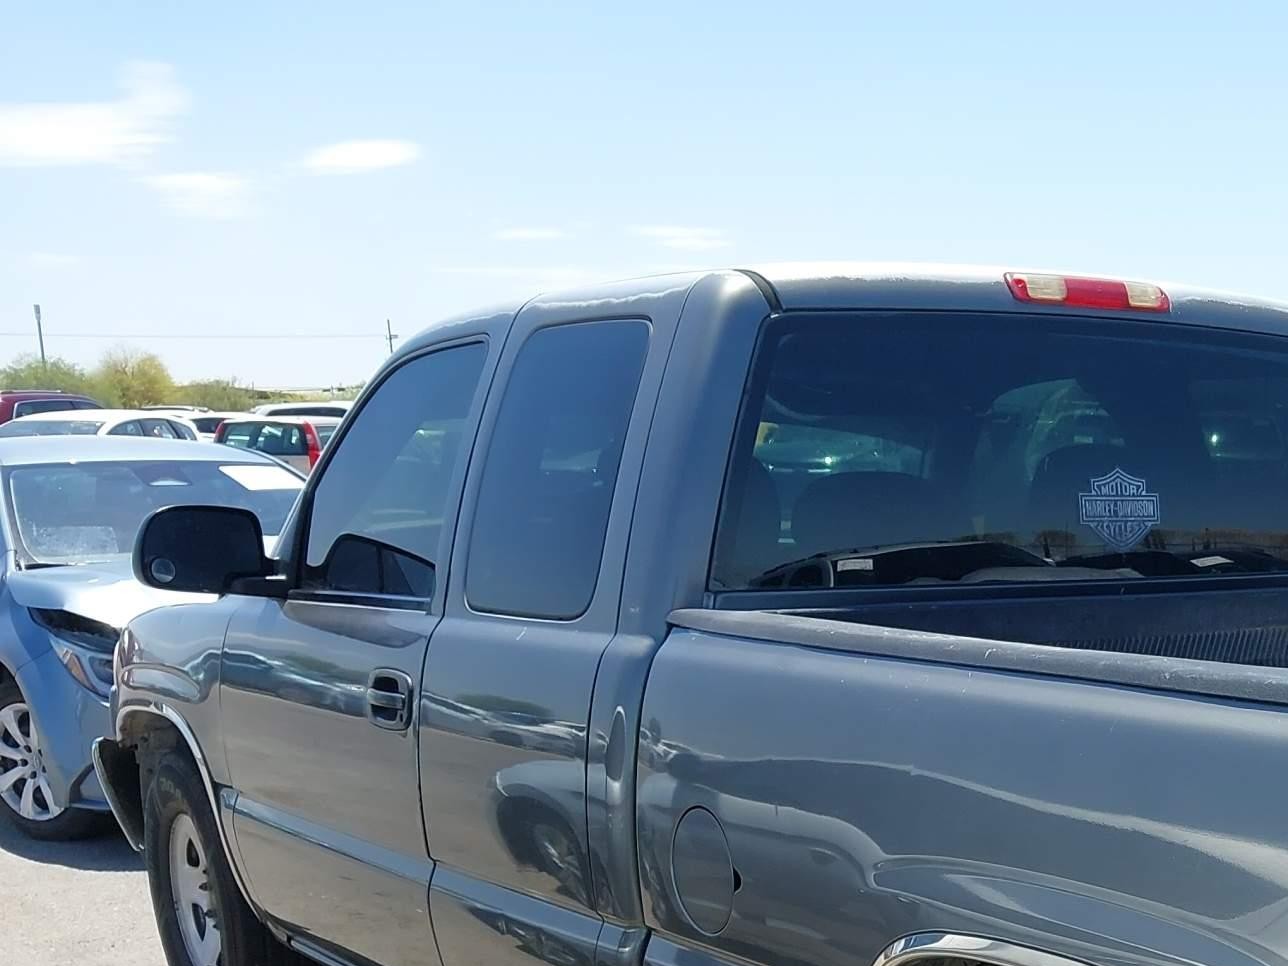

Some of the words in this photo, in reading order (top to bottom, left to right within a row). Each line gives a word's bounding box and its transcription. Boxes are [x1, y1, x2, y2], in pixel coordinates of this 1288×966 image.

[1101, 479, 1138, 496] MOTOR
[1086, 501, 1154, 517] HARLEY-DAVIDSON
[1104, 521, 1139, 537] CYCLES
